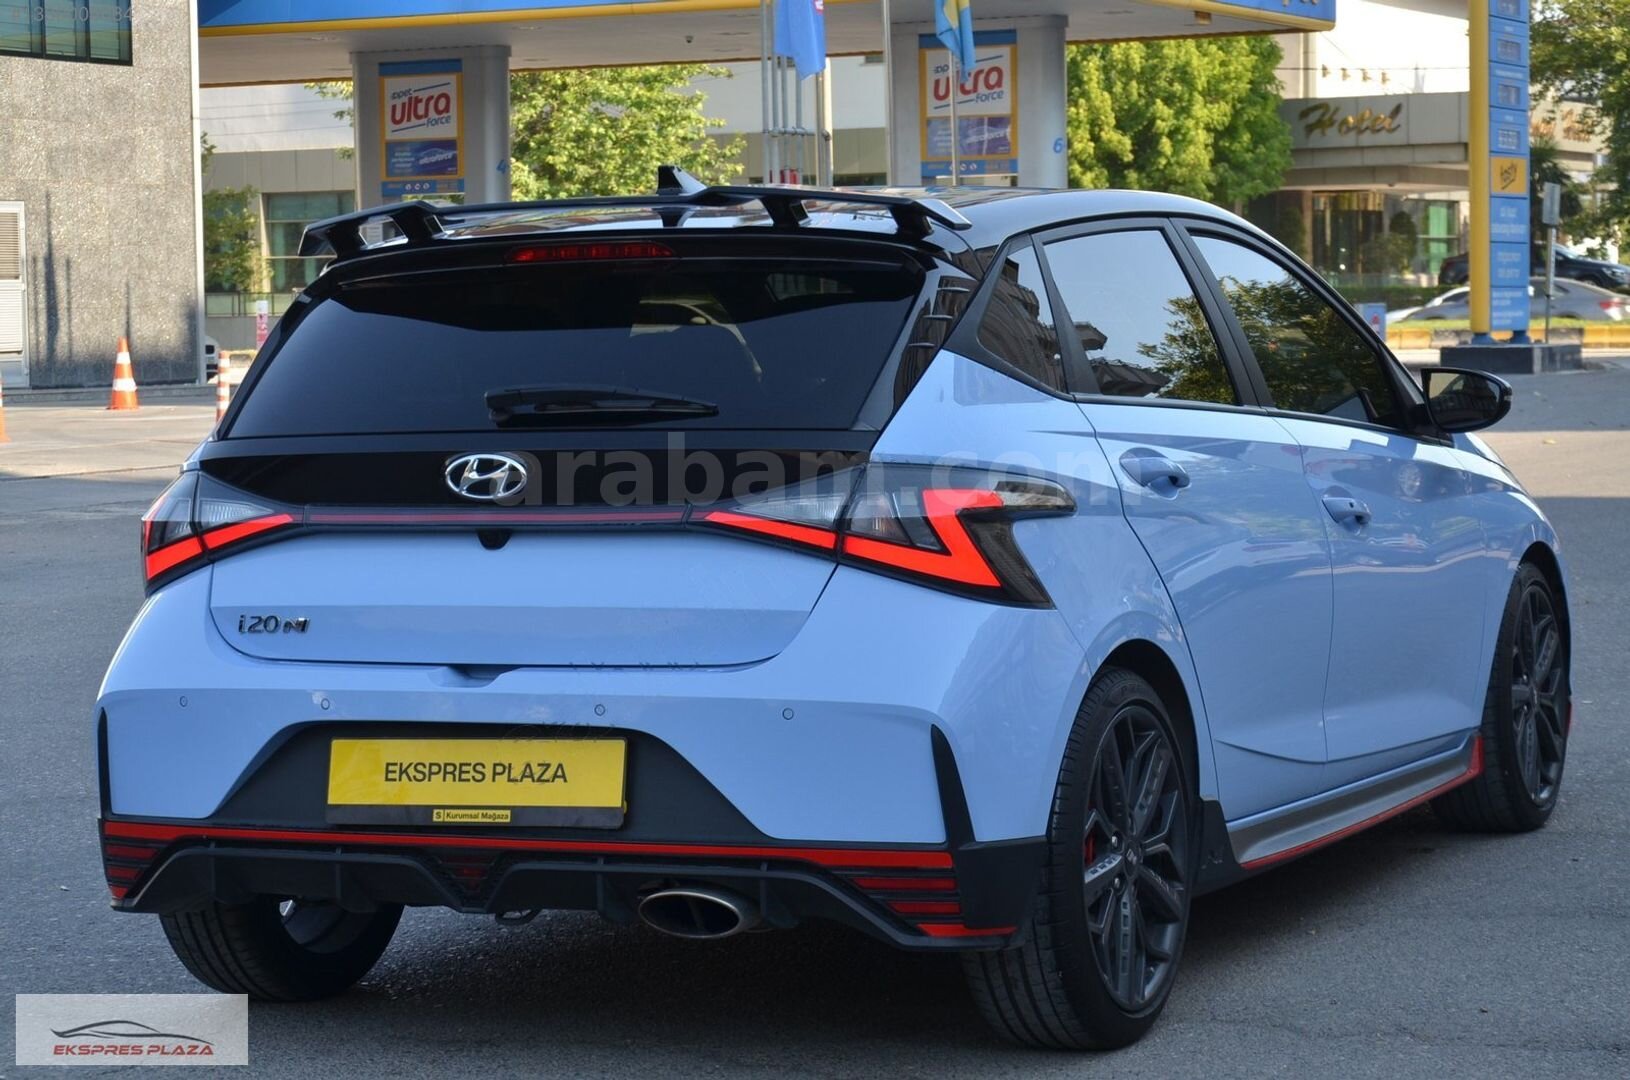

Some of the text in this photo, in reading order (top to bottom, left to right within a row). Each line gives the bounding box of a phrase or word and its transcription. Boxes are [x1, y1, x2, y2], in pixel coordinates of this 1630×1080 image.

[976, 90, 1004, 103] force
[391, 92, 451, 125] ultra
[426, 115, 452, 128] force
[1298, 102, 1403, 139] Hotel
[1053, 137, 1065, 154] 6
[496, 158, 508, 174] 4
[238, 614, 280, 634] i20
[384, 762, 568, 783] EKSPRES PLAZA
[434, 811, 509, 821] S Kurumsal Mağaza
